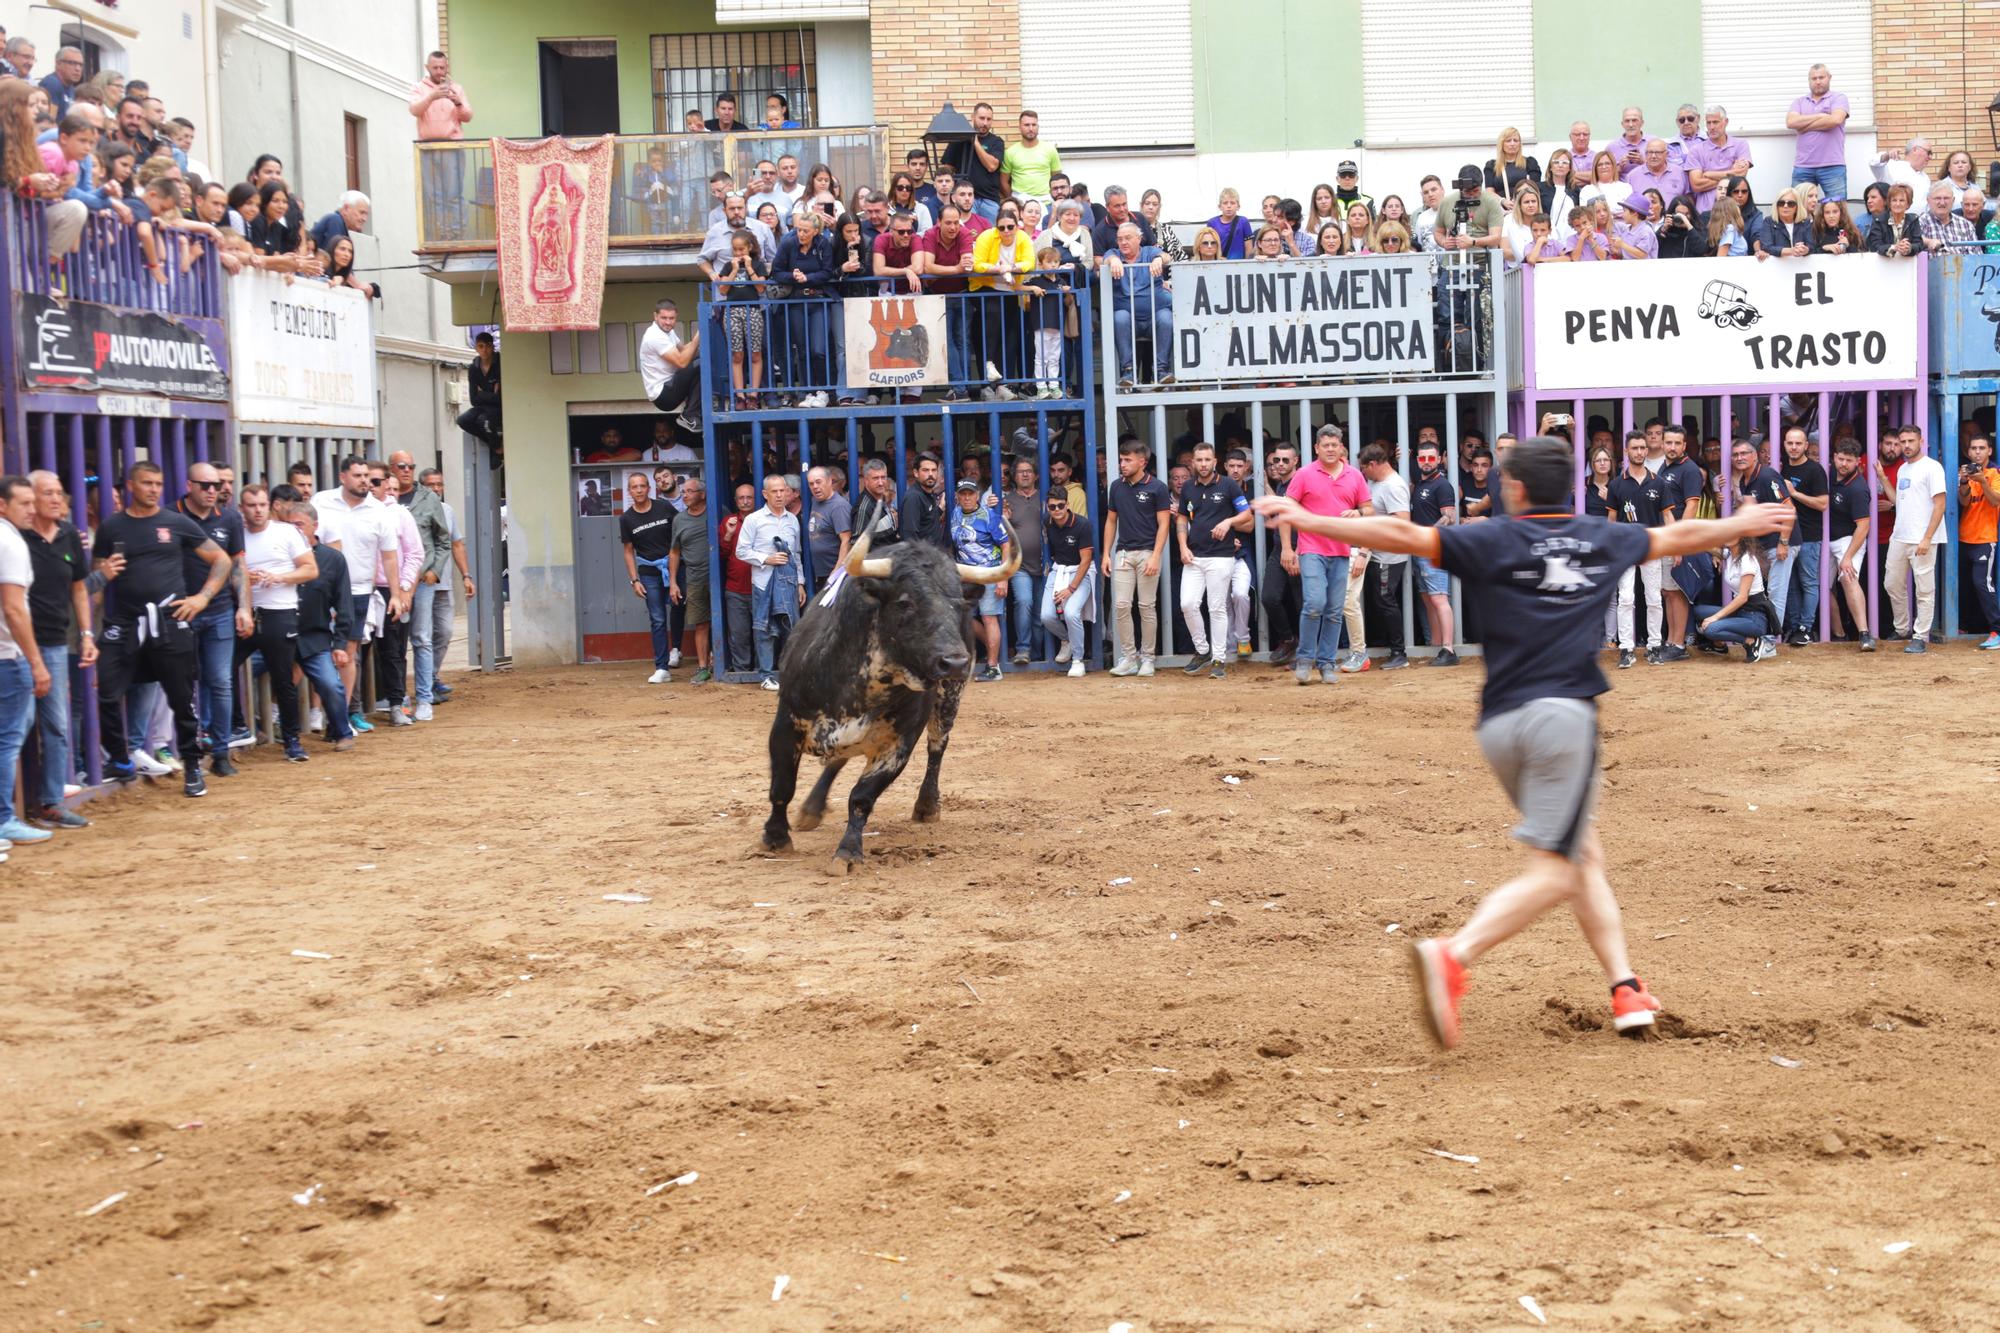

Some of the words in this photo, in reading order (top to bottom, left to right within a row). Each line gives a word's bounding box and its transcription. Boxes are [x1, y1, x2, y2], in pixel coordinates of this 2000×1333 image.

[1193, 268, 1412, 315] AJUNTAMENT
[1795, 271, 1834, 306] EL
[1228, 320, 1427, 367] ALMASSORA
[1565, 303, 1680, 345] PENYA
[1744, 330, 1887, 370] TRASTO
[869, 369, 925, 385] CLAFIDORS
